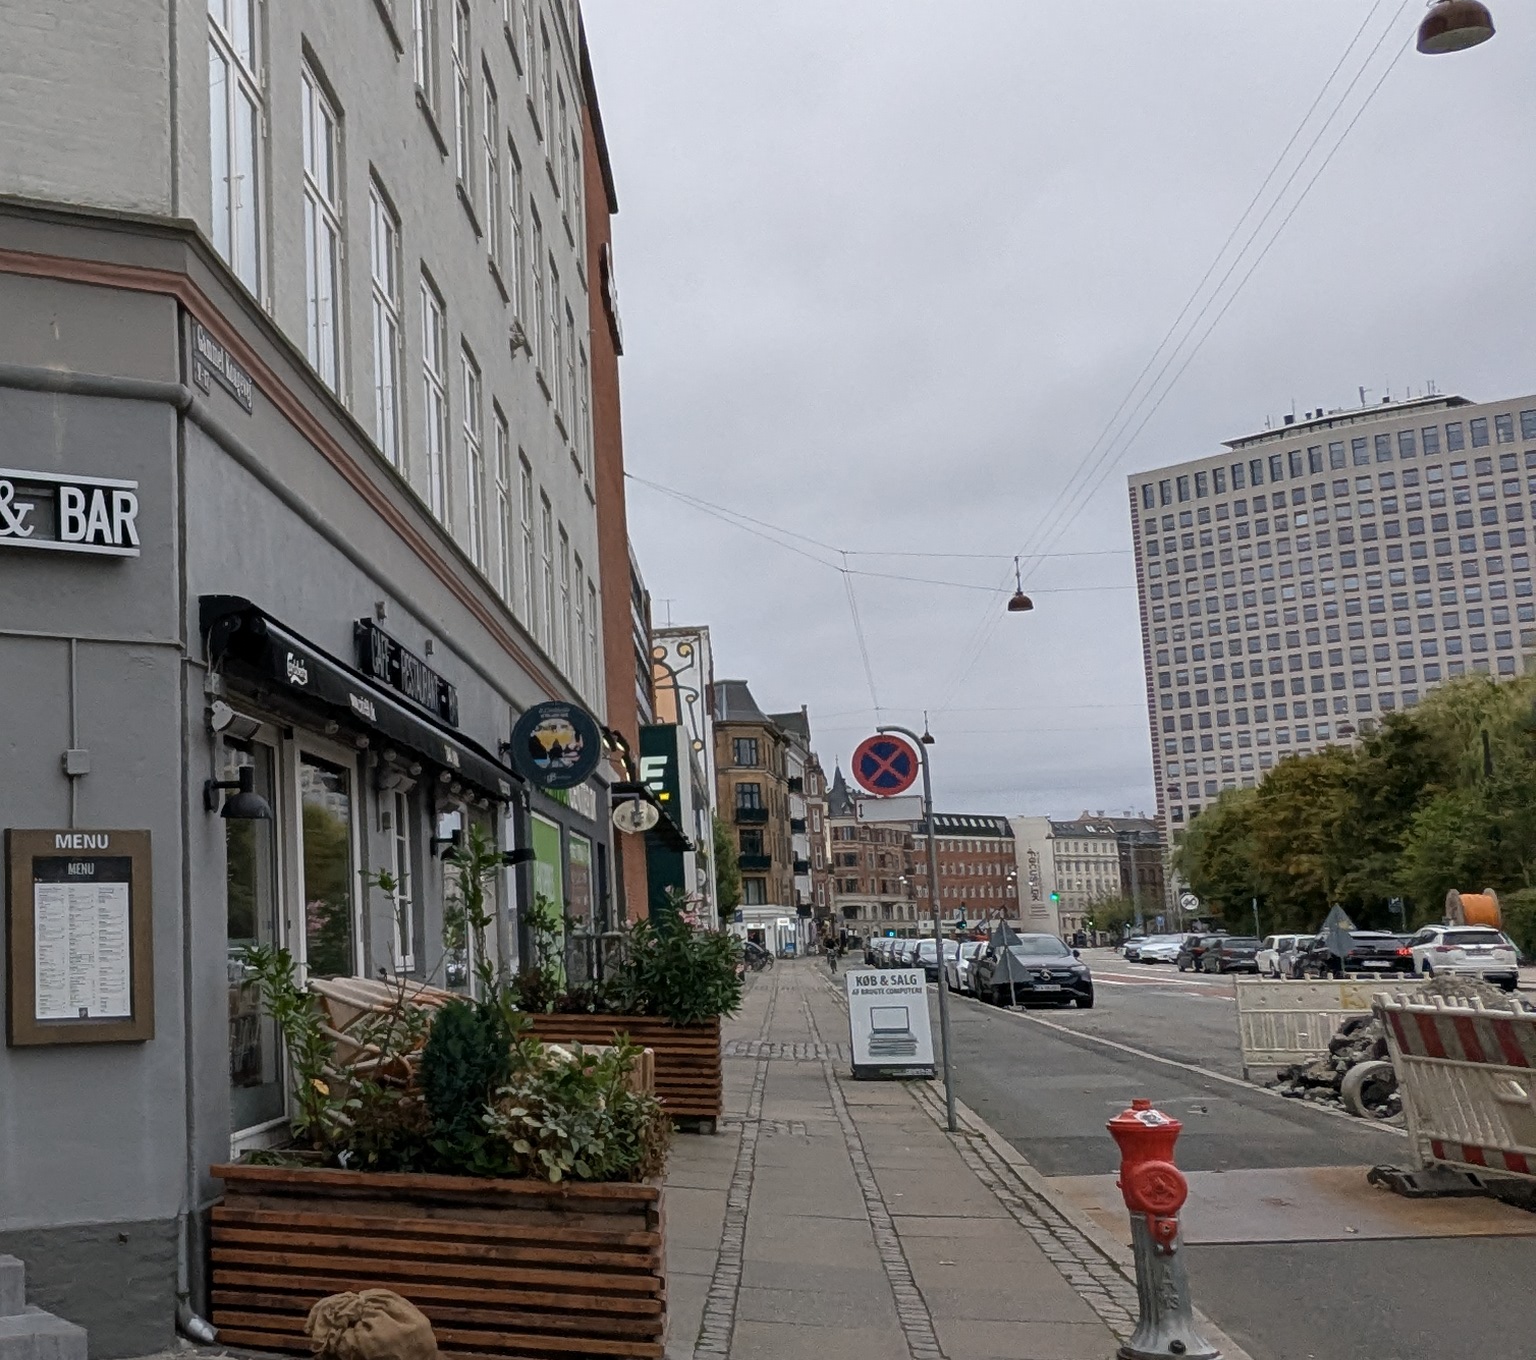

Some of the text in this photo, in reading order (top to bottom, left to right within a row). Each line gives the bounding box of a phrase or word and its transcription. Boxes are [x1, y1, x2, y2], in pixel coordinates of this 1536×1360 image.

[58, 485, 141, 547] BAR
[55, 833, 110, 850] MENU
[67, 862, 95, 876] MENU
[855, 974, 918, 987] KØB & SALG
